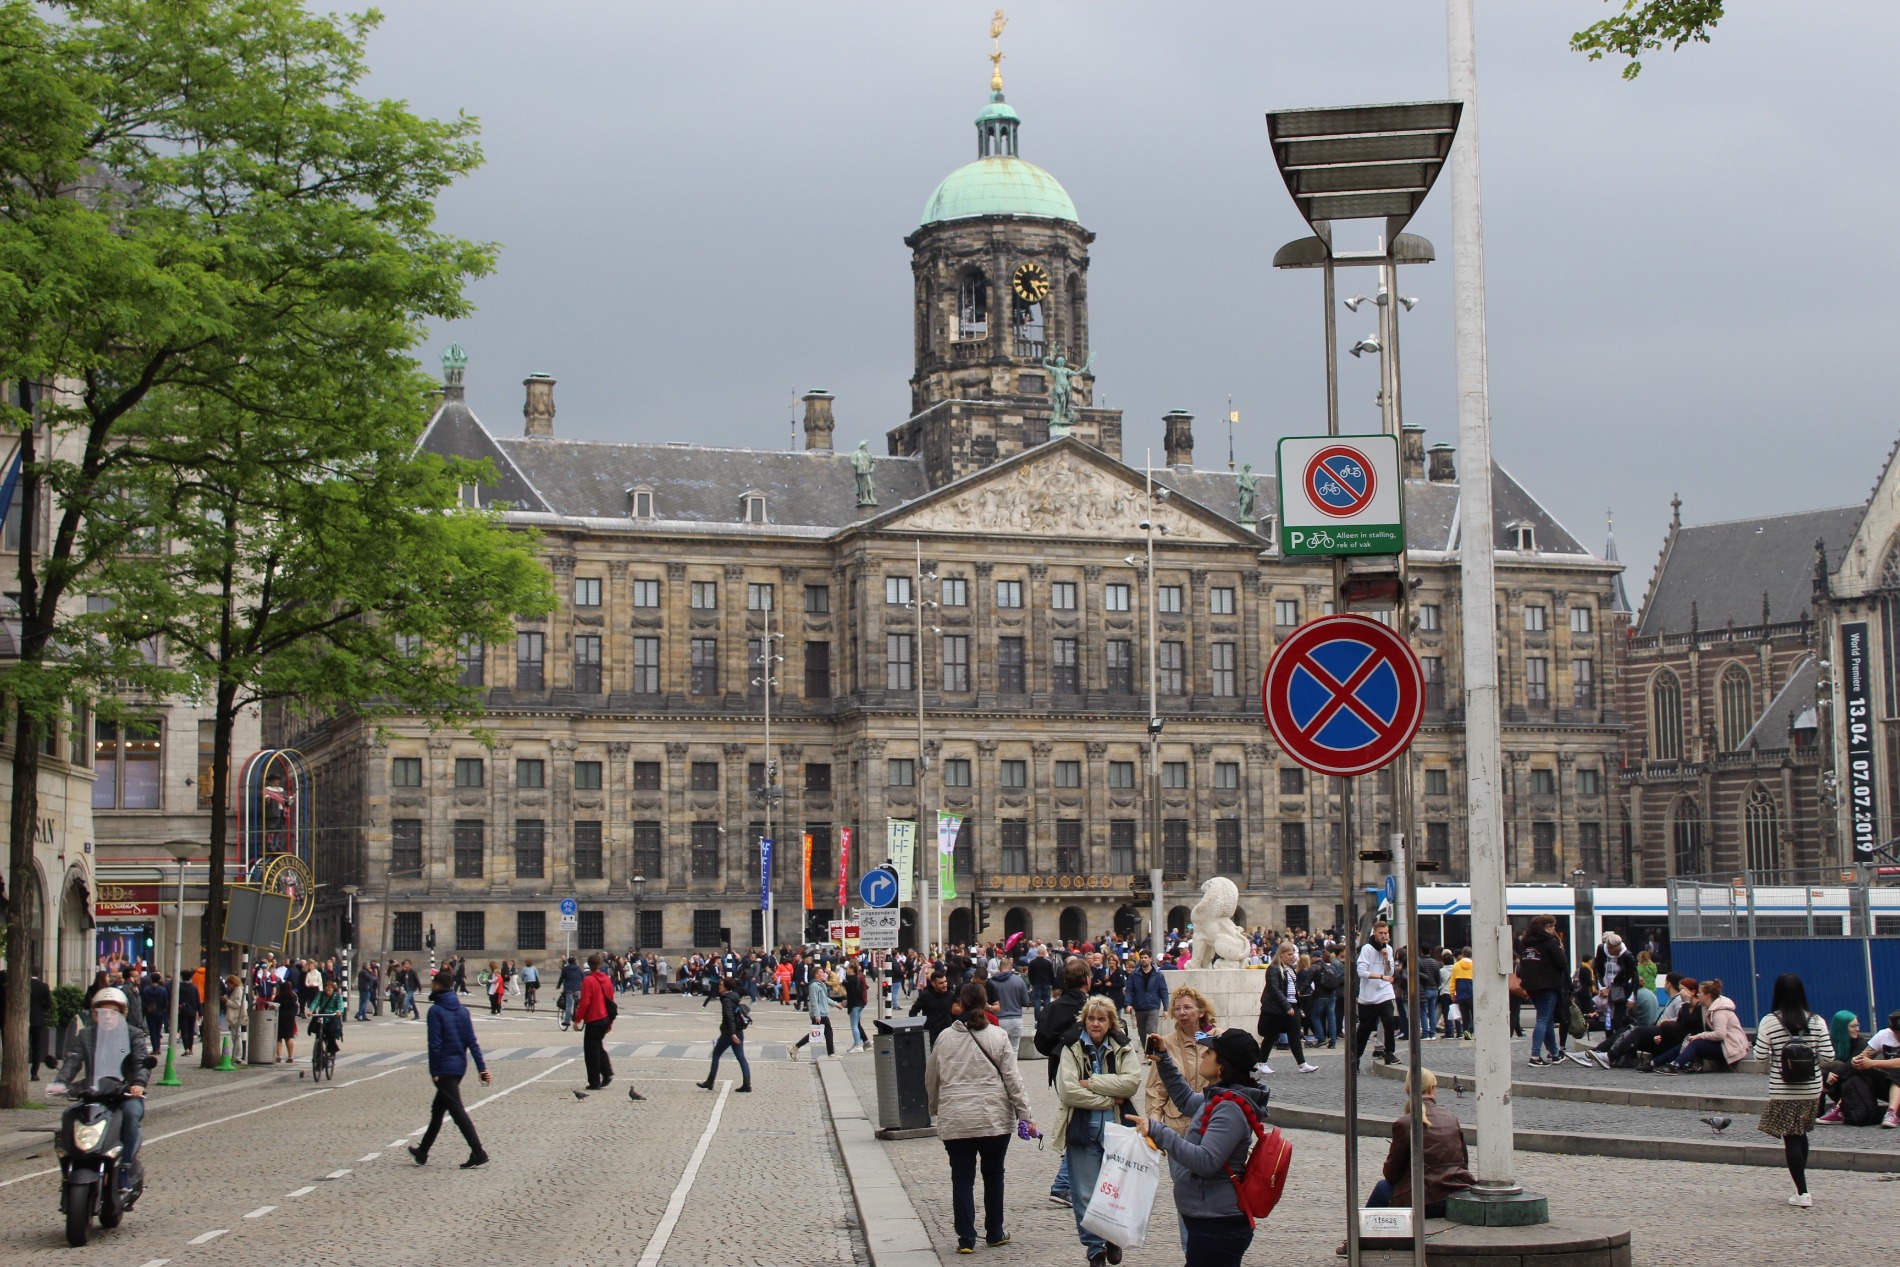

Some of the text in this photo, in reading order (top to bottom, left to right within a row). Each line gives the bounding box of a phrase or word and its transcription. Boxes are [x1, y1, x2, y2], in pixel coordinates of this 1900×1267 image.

[1290, 531, 1304, 549] P
[1336, 540, 1372, 549] rek of vak
[1360, 531, 1367, 539] in
[1850, 632, 1861, 657] World
[1851, 658, 1862, 692] Premiere
[1850, 697, 1868, 745] 13.04
[1852, 760, 1874, 852] 07.07.2019
[1100, 1181, 1120, 1199] 85%
